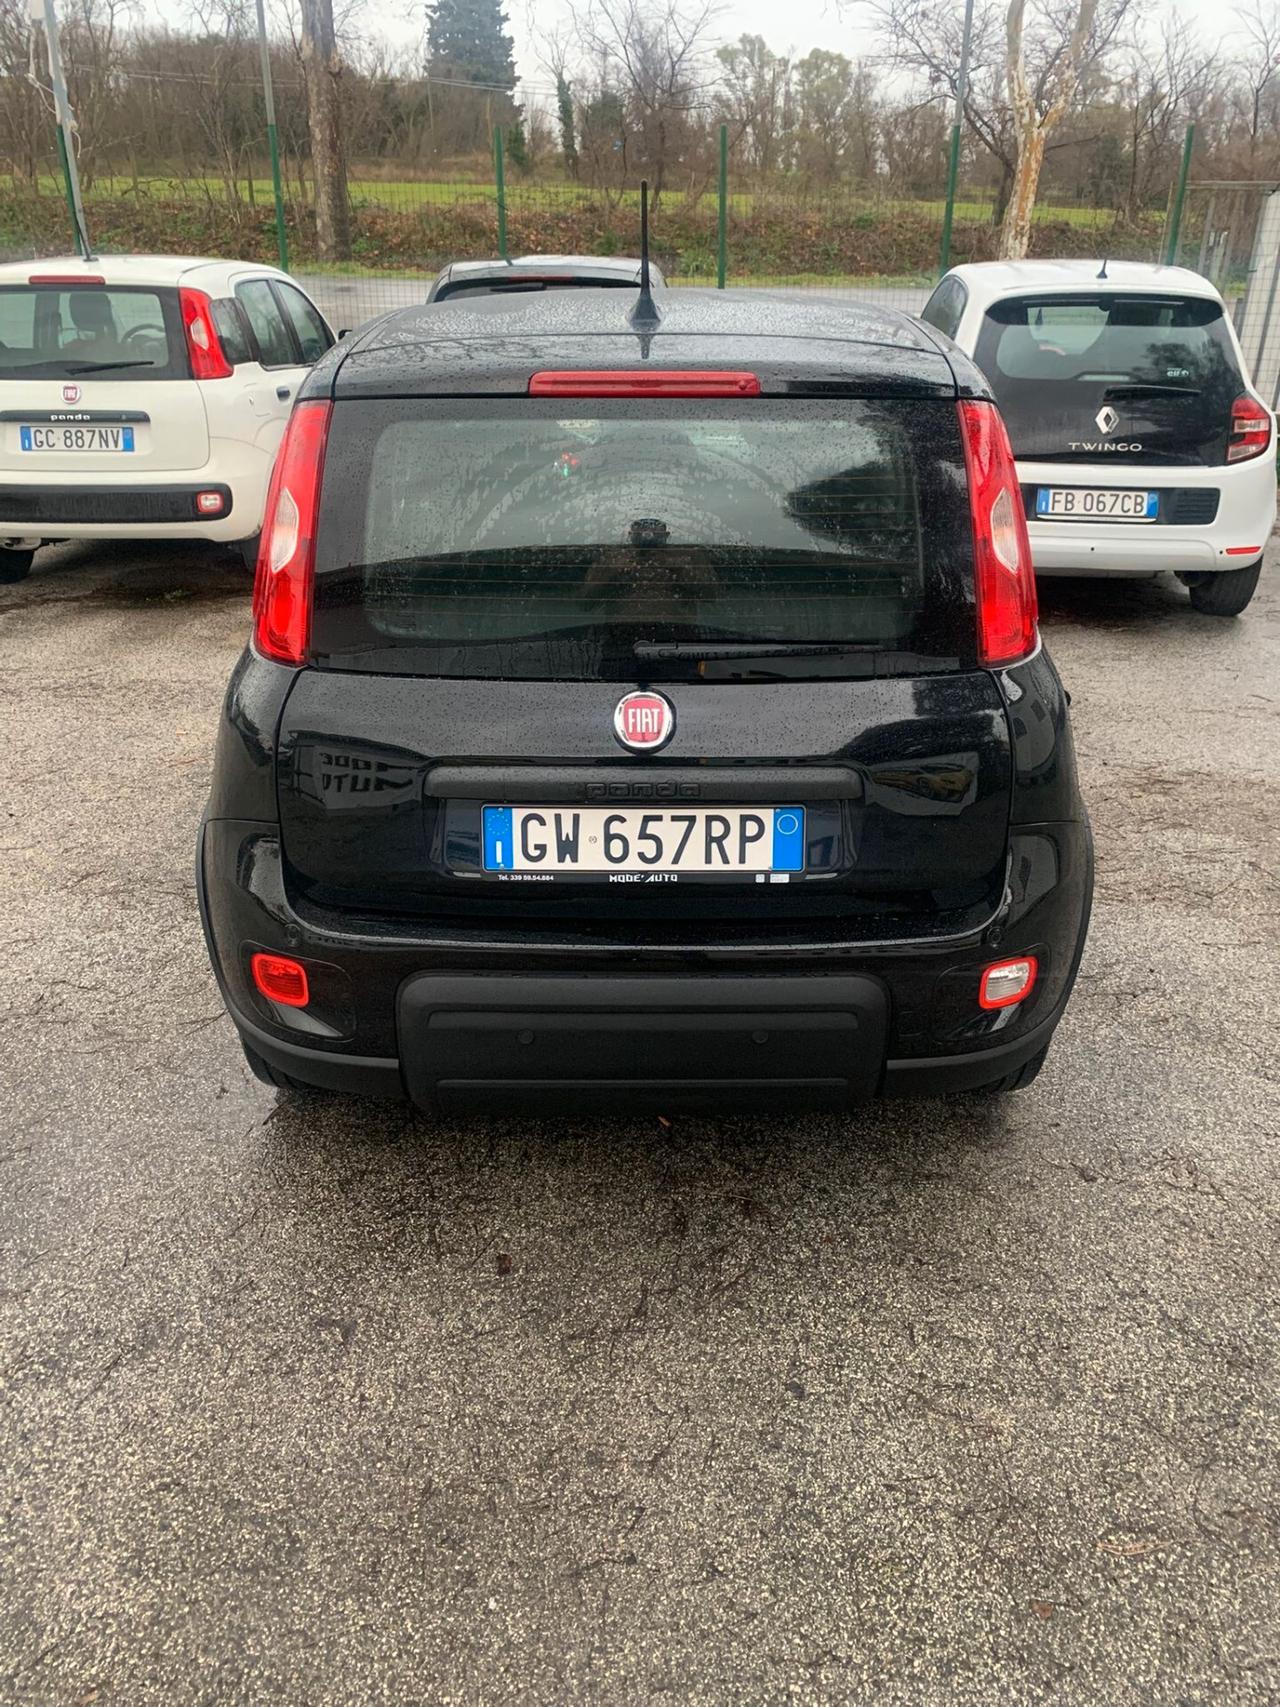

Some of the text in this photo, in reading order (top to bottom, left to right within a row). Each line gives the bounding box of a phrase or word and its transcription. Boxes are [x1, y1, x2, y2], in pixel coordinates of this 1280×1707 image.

[33, 429, 56, 448] GC
[63, 429, 120, 449] 887NV
[1068, 442, 1143, 451] TWINGO
[1051, 491, 1075, 511] FB
[1083, 492, 1145, 513] 067CB
[627, 707, 661, 734] FIAT
[584, 779, 700, 799] panda
[520, 812, 581, 864] GW
[603, 813, 766, 866] 657RP
